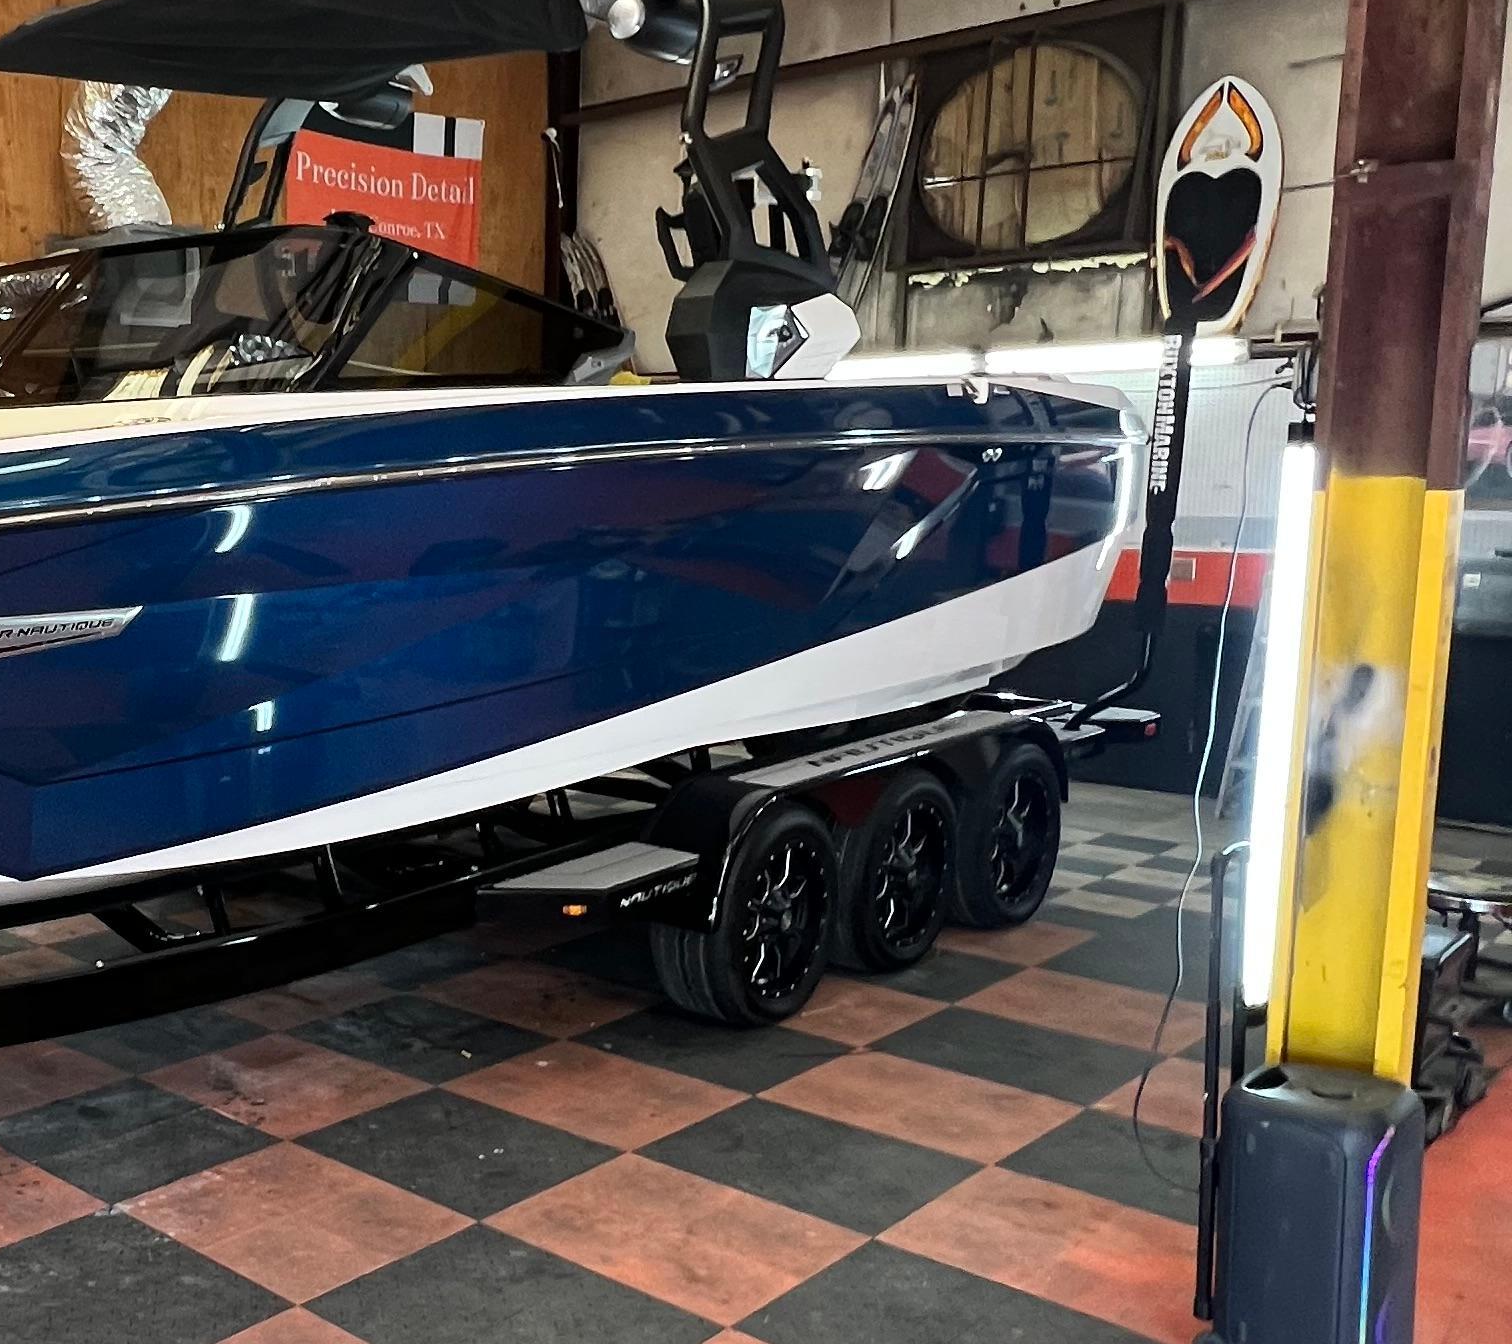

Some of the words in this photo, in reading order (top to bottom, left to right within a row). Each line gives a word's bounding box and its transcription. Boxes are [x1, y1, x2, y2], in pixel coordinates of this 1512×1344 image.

[295, 150, 403, 199] Precision
[410, 171, 475, 206] Detail
[424, 221, 446, 240] TX
[15, 617, 116, 638] NAUTIQUE
